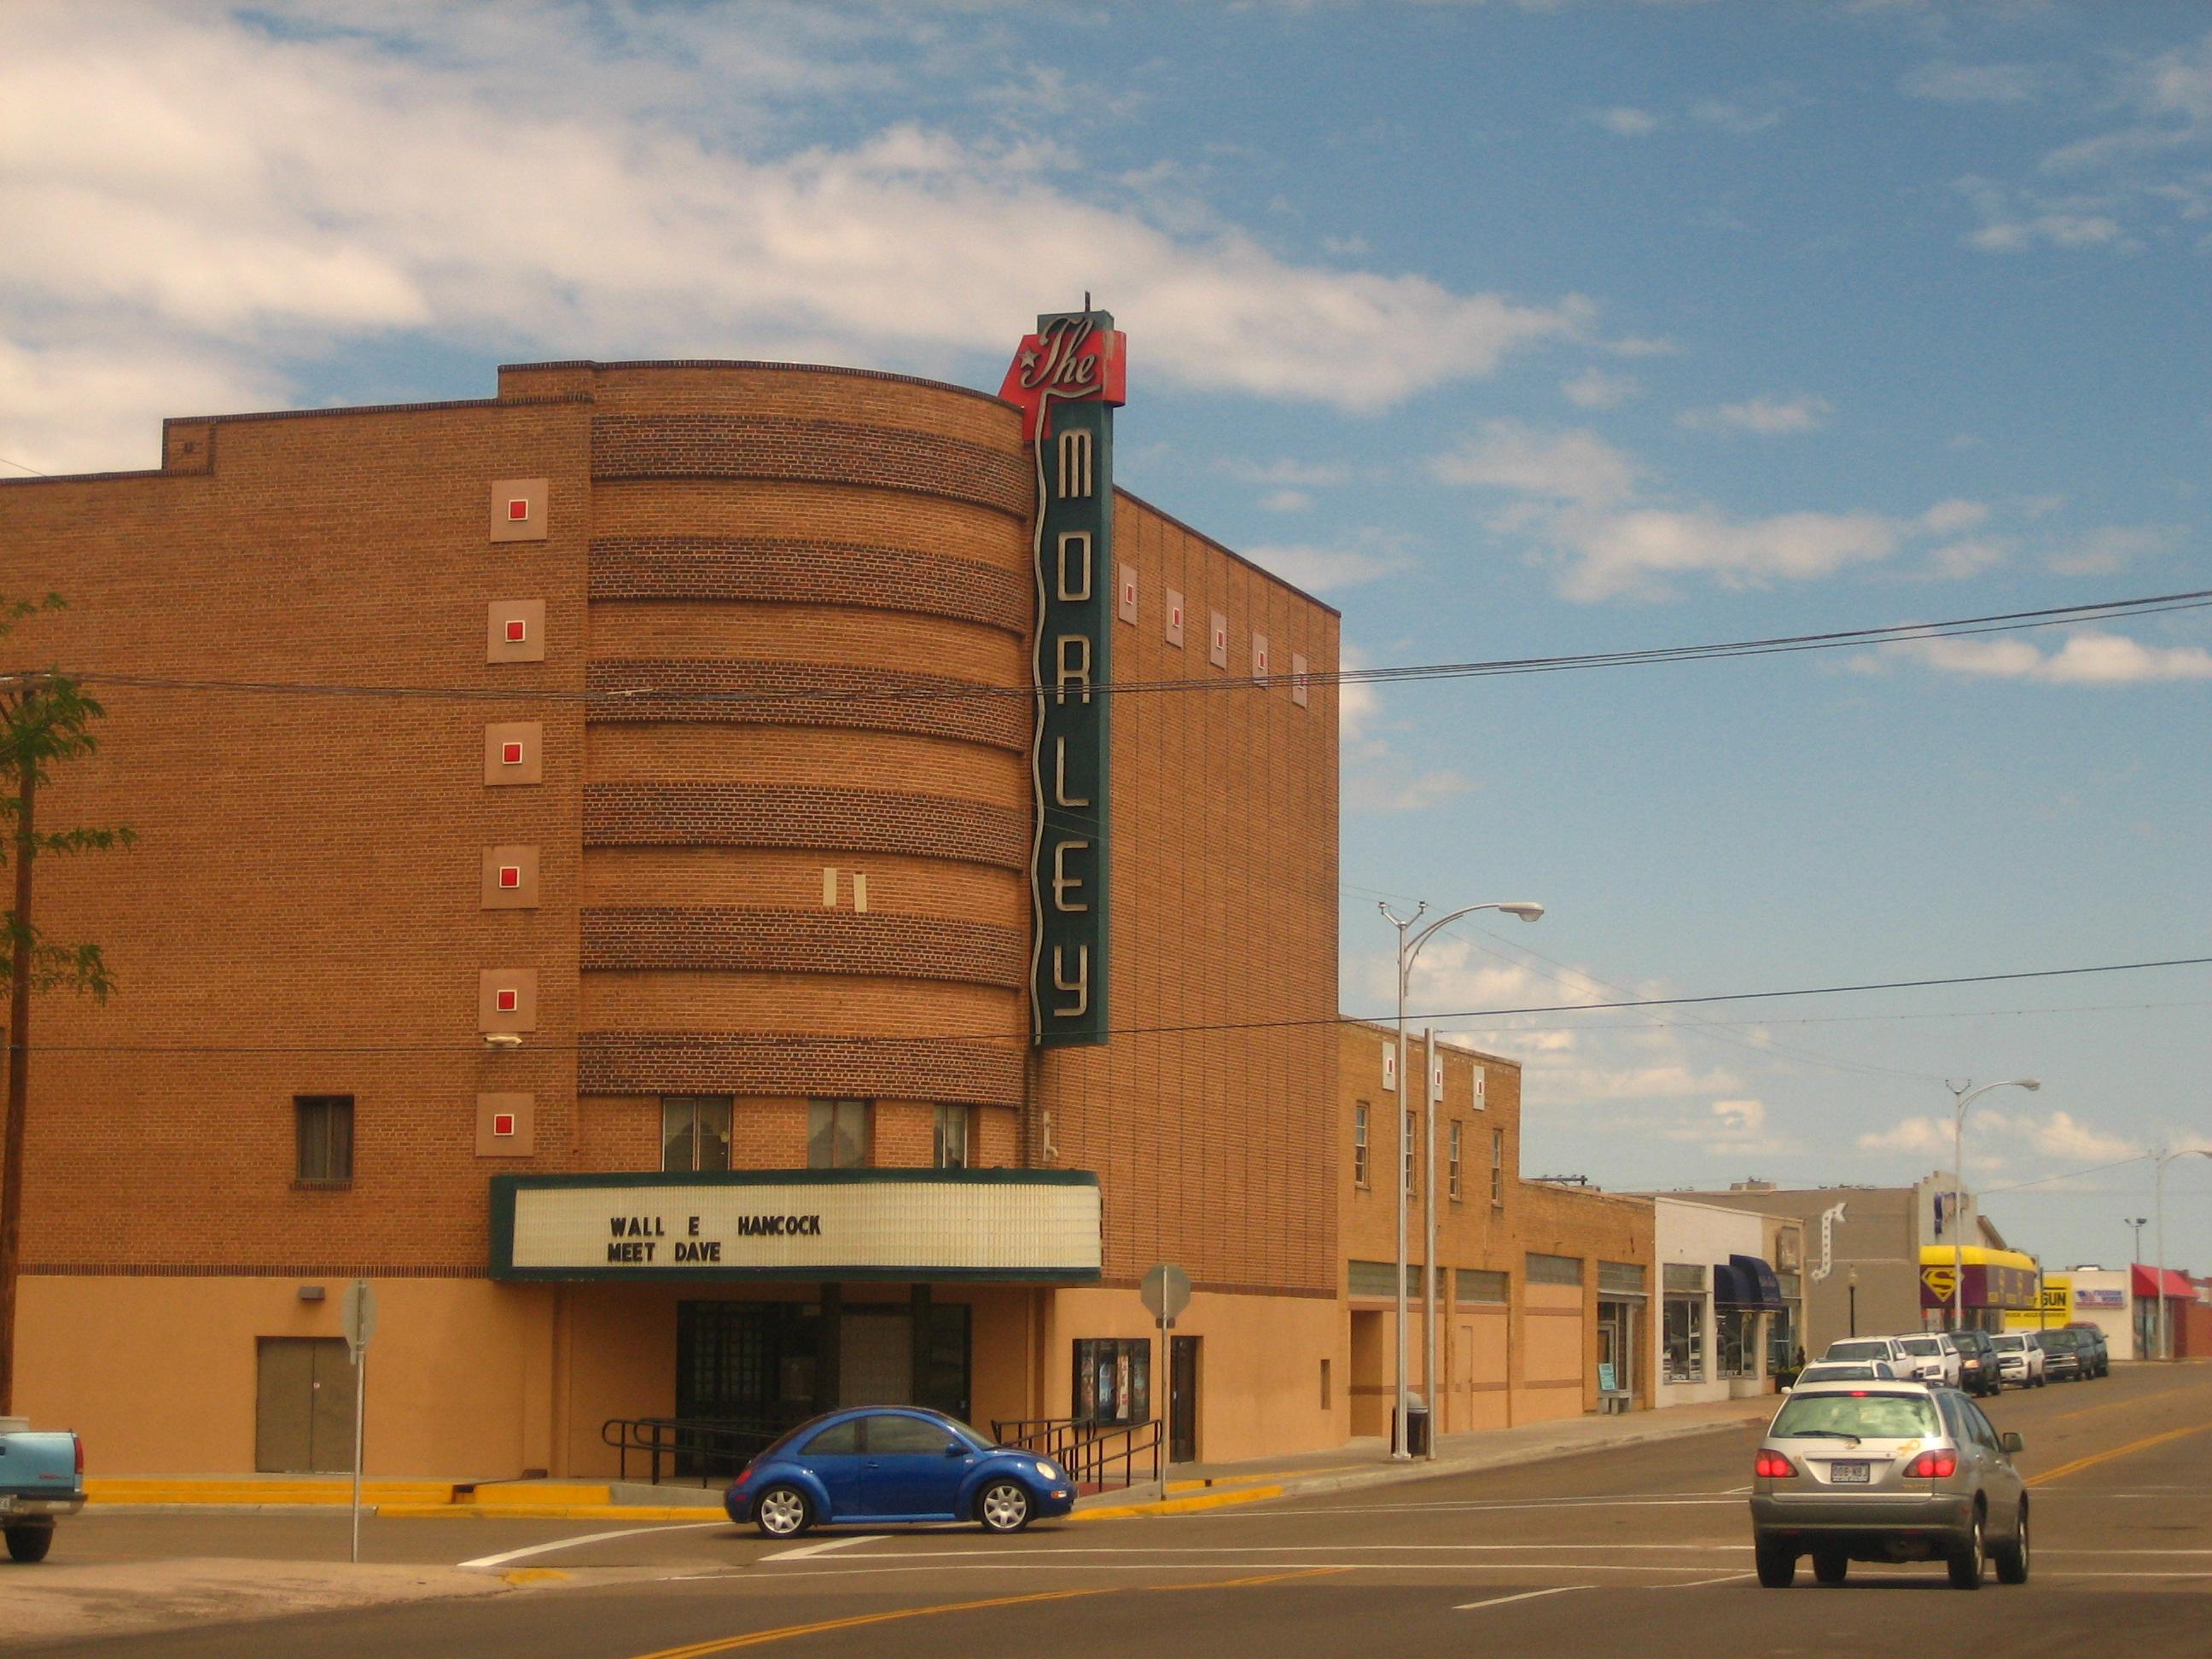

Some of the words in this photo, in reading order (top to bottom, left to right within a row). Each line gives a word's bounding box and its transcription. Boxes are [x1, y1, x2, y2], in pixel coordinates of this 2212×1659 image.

[1021, 317, 1095, 387] The
[1052, 428, 1091, 1016] MORLEY
[610, 1216, 664, 1237] WALL
[688, 1216, 700, 1236] E
[737, 1215, 821, 1236] HANCOCK
[607, 1243, 655, 1262] MEET
[674, 1242, 721, 1261] DAVE
[2042, 1292, 2066, 1306] GUN
